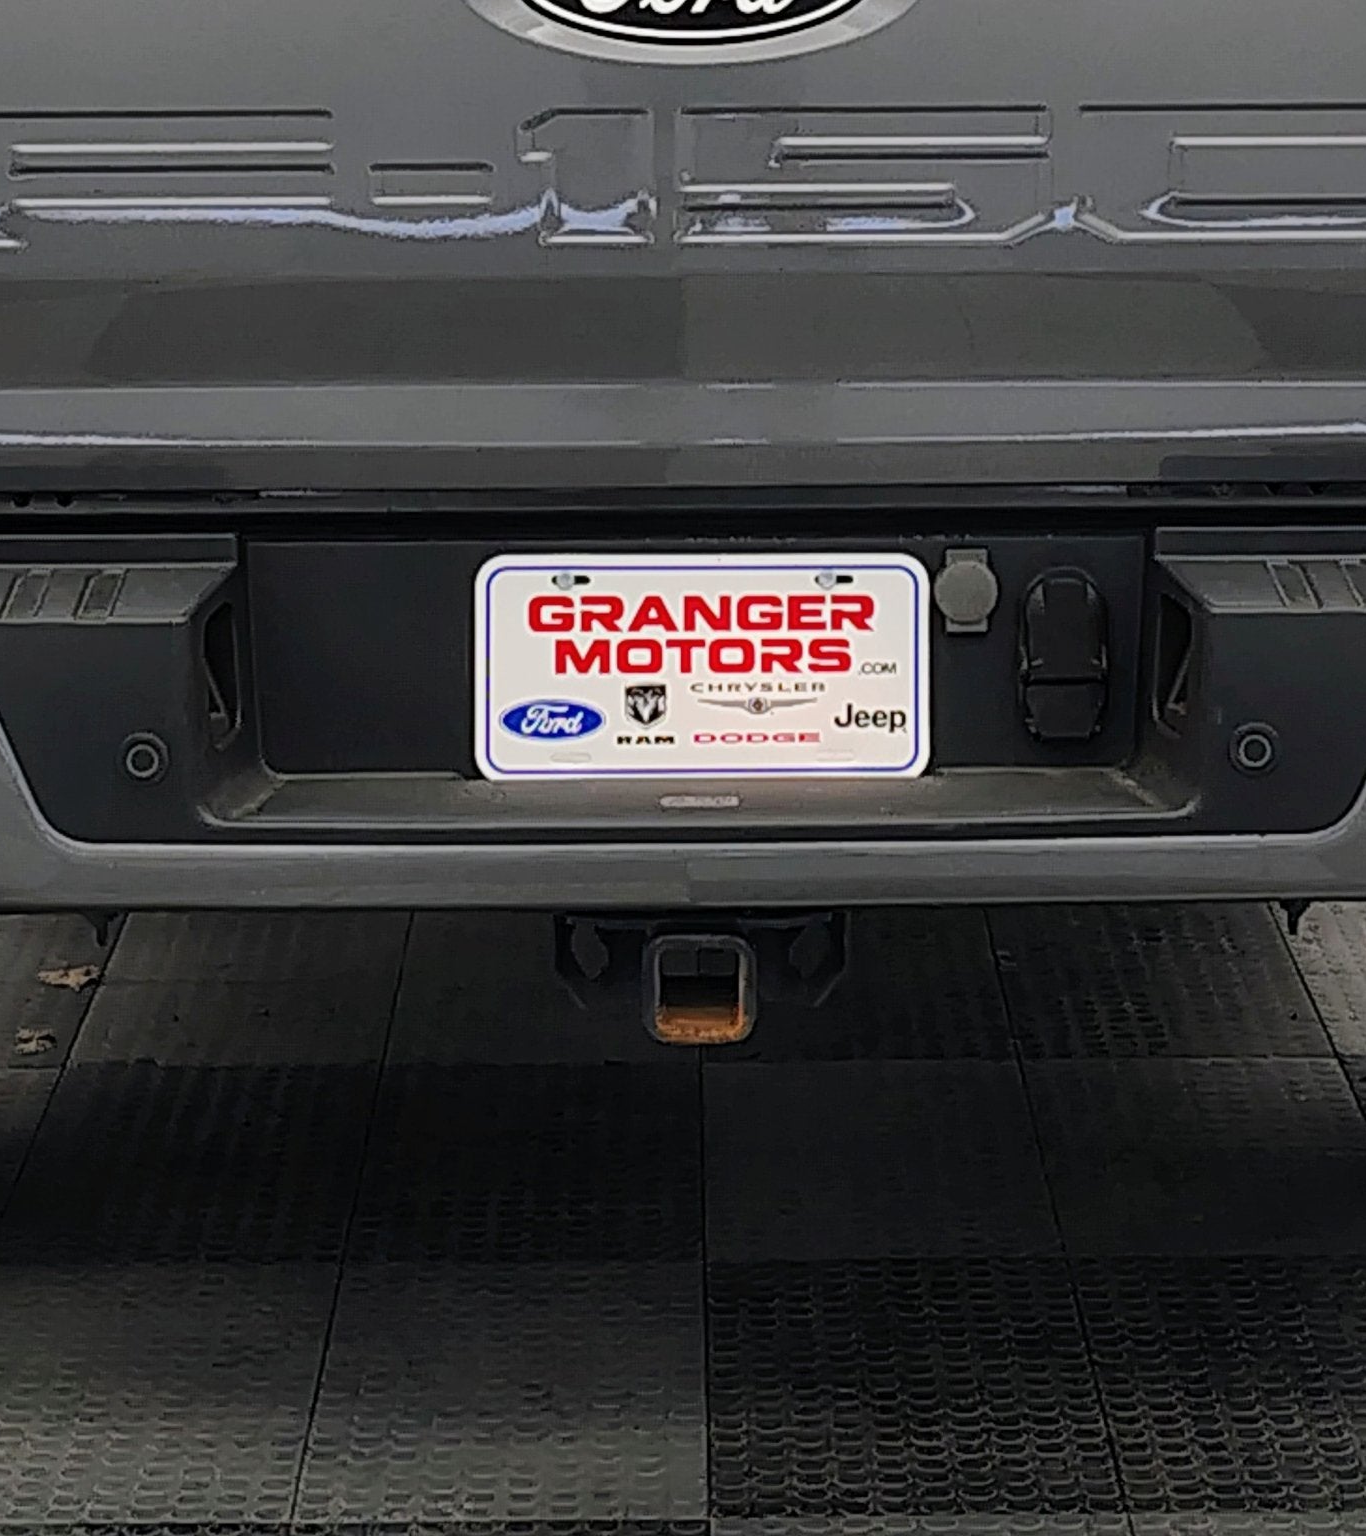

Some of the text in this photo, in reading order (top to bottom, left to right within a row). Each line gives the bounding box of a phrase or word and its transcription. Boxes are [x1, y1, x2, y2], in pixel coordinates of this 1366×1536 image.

[528, 595, 875, 632] GRANGER
[554, 638, 852, 675] MOTORS
[690, 681, 826, 694] CHRYSLER
[519, 703, 584, 735] Ford
[834, 704, 906, 732] Jeep
[616, 735, 676, 745] RAM
[693, 732, 821, 743] DODGE
